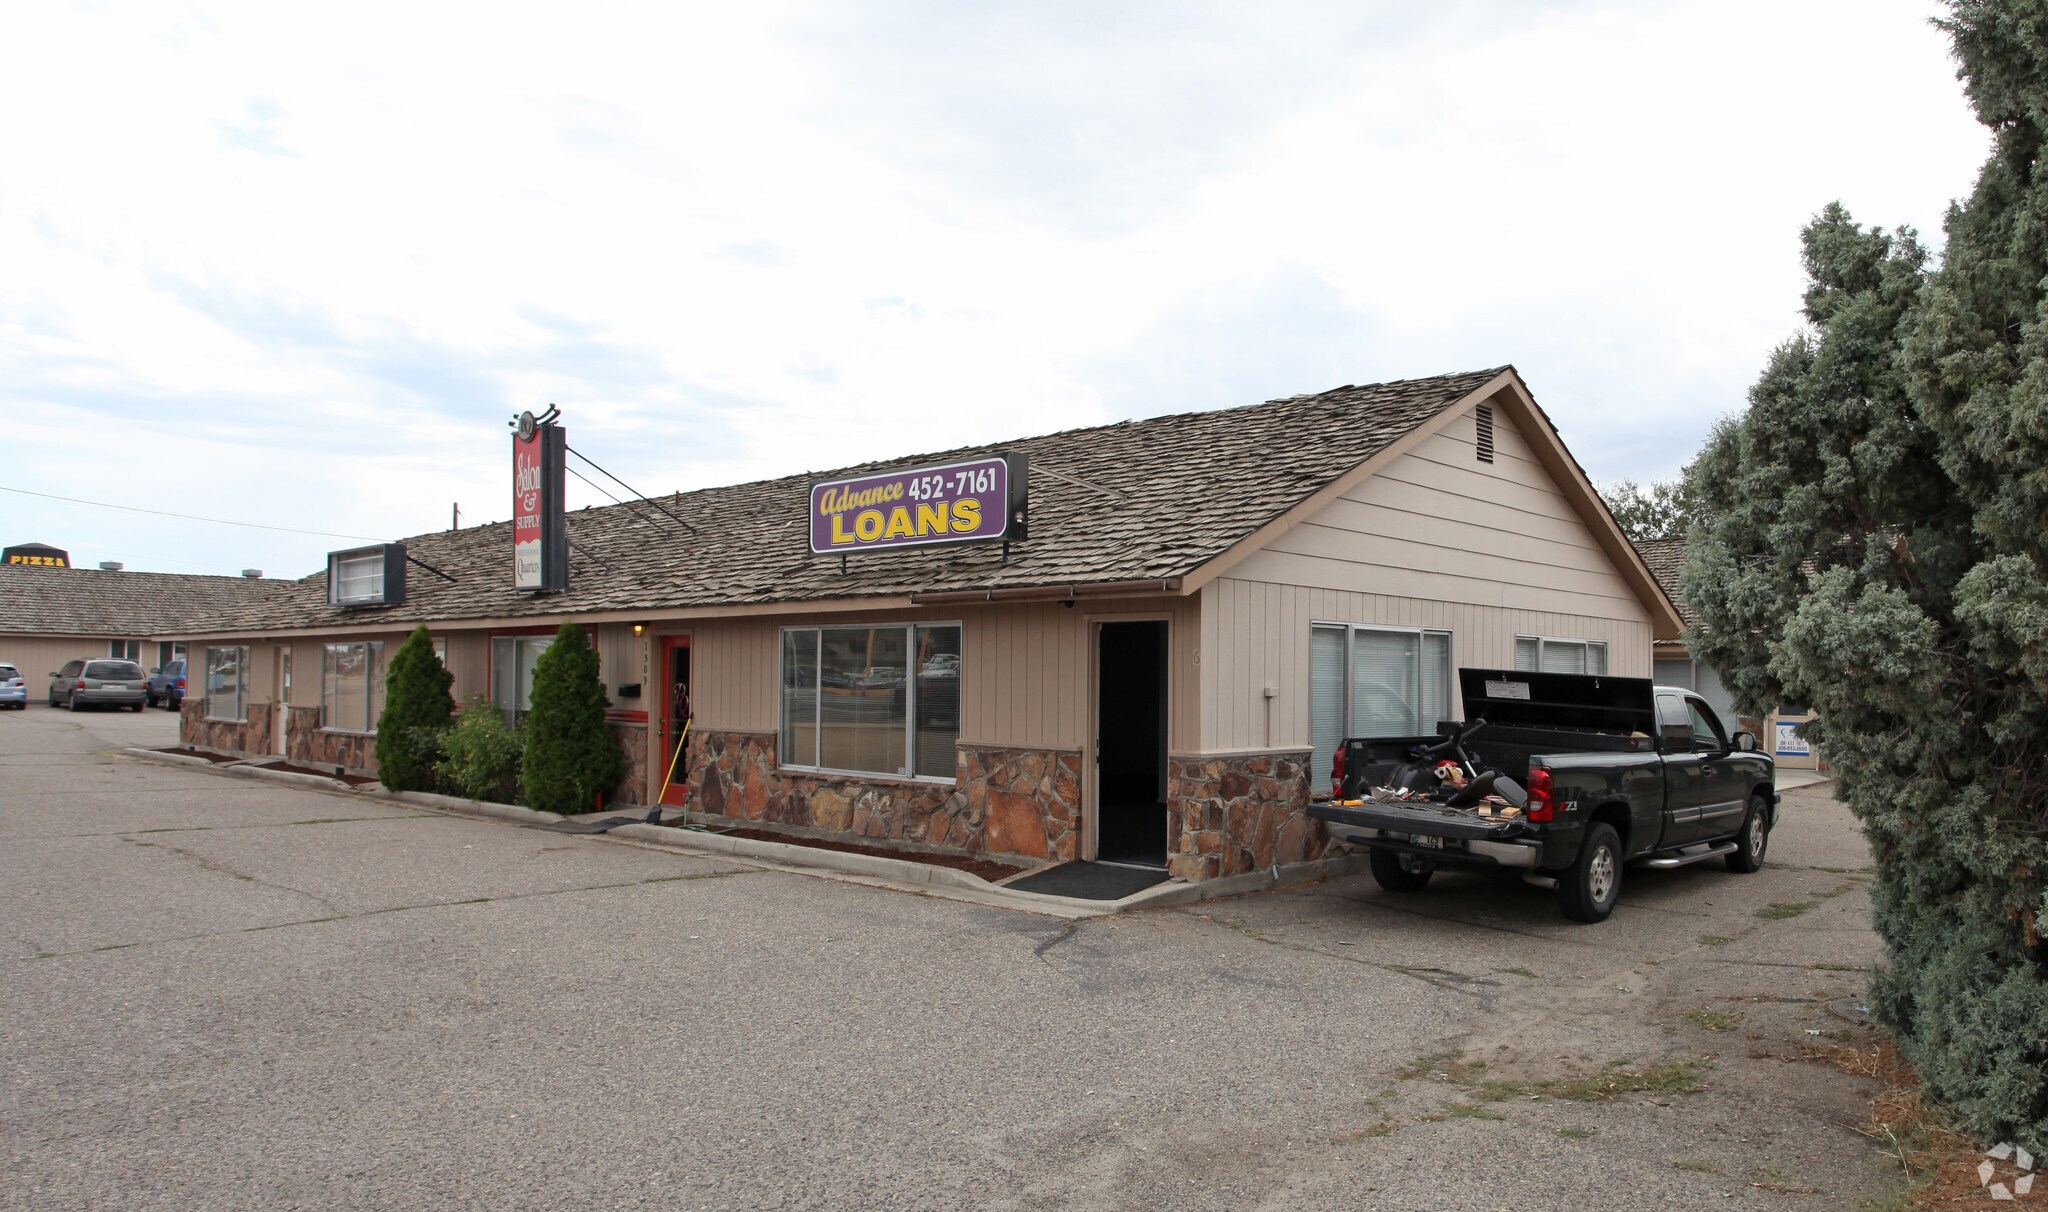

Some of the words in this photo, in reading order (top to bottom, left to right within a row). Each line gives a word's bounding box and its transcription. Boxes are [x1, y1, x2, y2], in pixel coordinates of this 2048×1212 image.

[516, 452, 541, 498] Salon
[820, 481, 905, 516] Advance
[908, 467, 996, 501] 452-7161
[523, 492, 537, 512] &
[516, 514, 541, 530] SUPPLY
[830, 497, 982, 546] LOANS
[9, 555, 65, 567] PIZZA
[1193, 648, 1200, 665] 6
[1558, 801, 1578, 811] Z71
